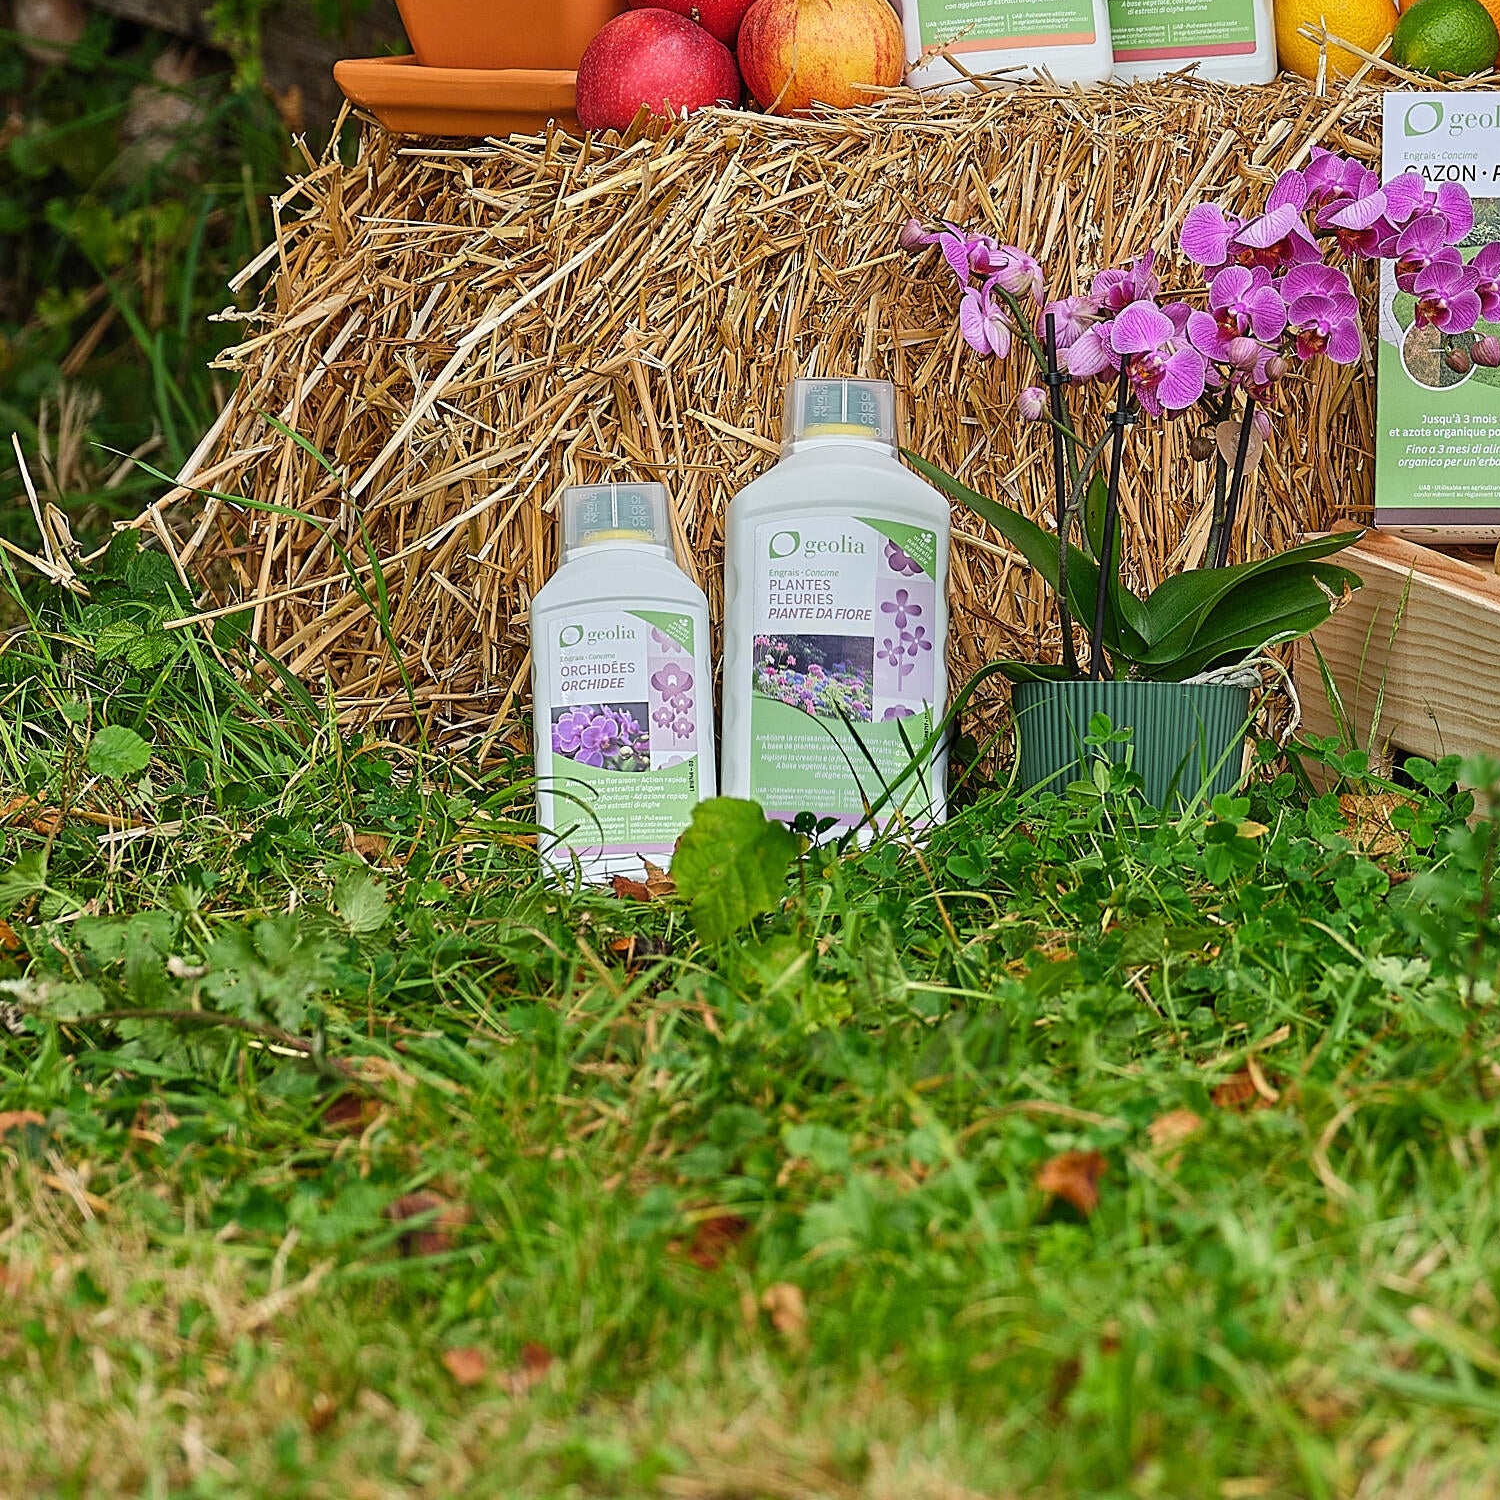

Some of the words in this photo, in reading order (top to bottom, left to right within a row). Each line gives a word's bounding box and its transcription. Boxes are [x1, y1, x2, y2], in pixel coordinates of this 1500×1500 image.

[1404, 152, 1435, 161] Engrais
[813, 408, 828, 416] 25
[861, 404, 875, 412] 20
[861, 415, 875, 423] 30
[1422, 414, 1460, 425] Jusqu'à
[1463, 414, 1470, 423] 3
[1472, 414, 1497, 423] mois
[1389, 428, 1400, 436] et
[1402, 428, 1431, 436] azote
[1433, 427, 1486, 438] organique
[1406, 444, 1427, 454] Fino
[1429, 446, 1436, 454] a
[1437, 444, 1444, 453] 3
[1446, 444, 1470, 454] mesi
[1471, 444, 1482, 453] di
[1398, 456, 1442, 468] organico
[1443, 458, 1462, 468] per
[804, 535, 865, 558] geolia
[907, 539, 932, 560] naturelle
[914, 535, 933, 553] origine
[904, 544, 928, 565] naturale
[769, 569, 799, 577] Engrais
[805, 569, 839, 577] Concime
[770, 580, 830, 590] PLANTES
[770, 594, 833, 604] FLEURIES
[768, 608, 813, 619] PIANTE
[816, 609, 833, 619] DA
[835, 609, 872, 620] FIORE
[588, 625, 635, 645] geolia
[561, 661, 635, 676] ORCHIDÉES
[562, 678, 624, 691] ORCHIDEE
